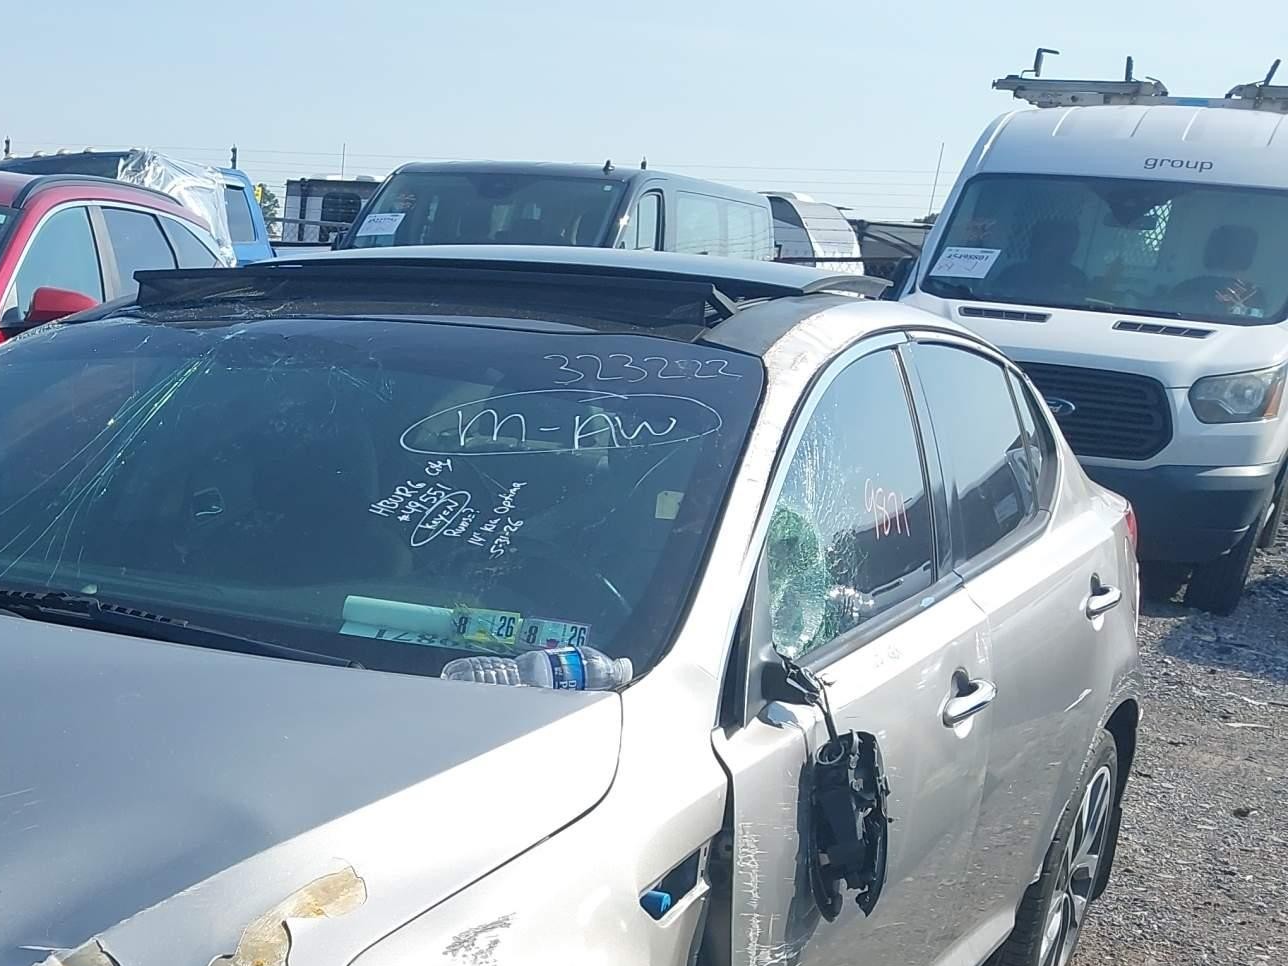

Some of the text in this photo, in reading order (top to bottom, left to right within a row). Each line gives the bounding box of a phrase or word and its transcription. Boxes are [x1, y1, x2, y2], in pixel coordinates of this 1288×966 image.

[1144, 157, 1214, 173] group
[864, 478, 910, 540] 9871
[457, 615, 516, 638] 8 26
[526, 625, 586, 646] 8 26
